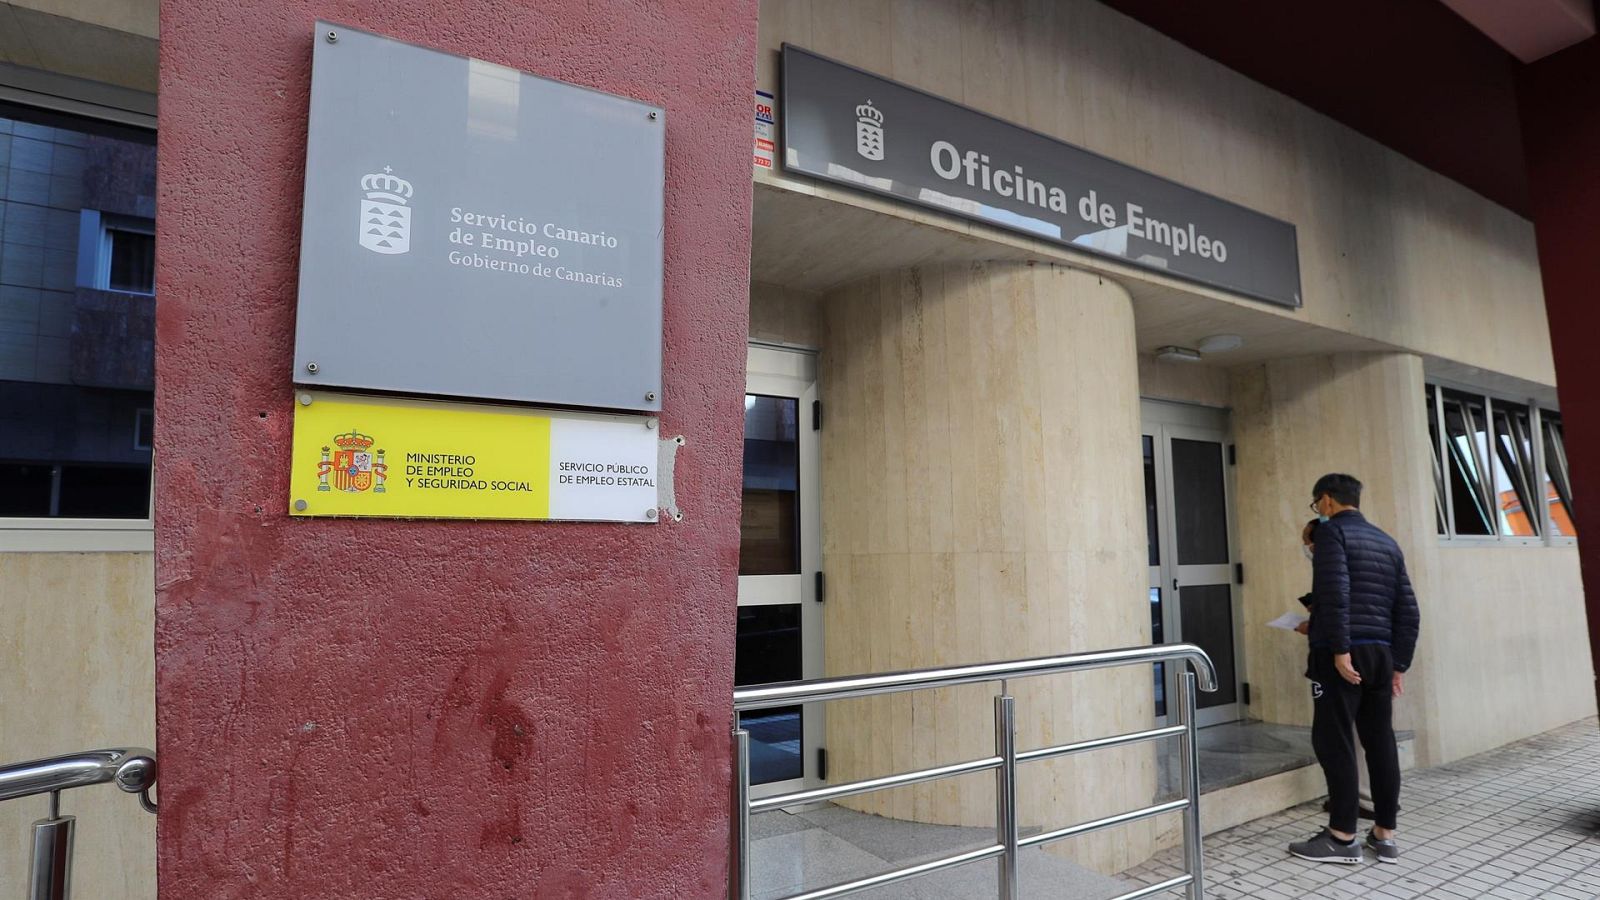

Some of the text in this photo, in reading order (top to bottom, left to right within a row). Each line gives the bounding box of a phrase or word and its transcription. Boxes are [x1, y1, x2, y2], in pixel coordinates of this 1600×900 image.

[930, 140, 1228, 264] Oficina de Empleo
[450, 207, 618, 249] Servicio Canario
[449, 227, 559, 259] de Empleo
[448, 251, 623, 288] Gobierno de Canarias
[406, 452, 476, 466] MINISTERIO
[406, 465, 474, 478] DE EMPLEO
[559, 461, 649, 475] SERVICIO PÚBLICO
[405, 478, 533, 492] Y SEGURIDAD SOCIAL
[559, 474, 655, 488] DE EMPLEO ESTATAL
